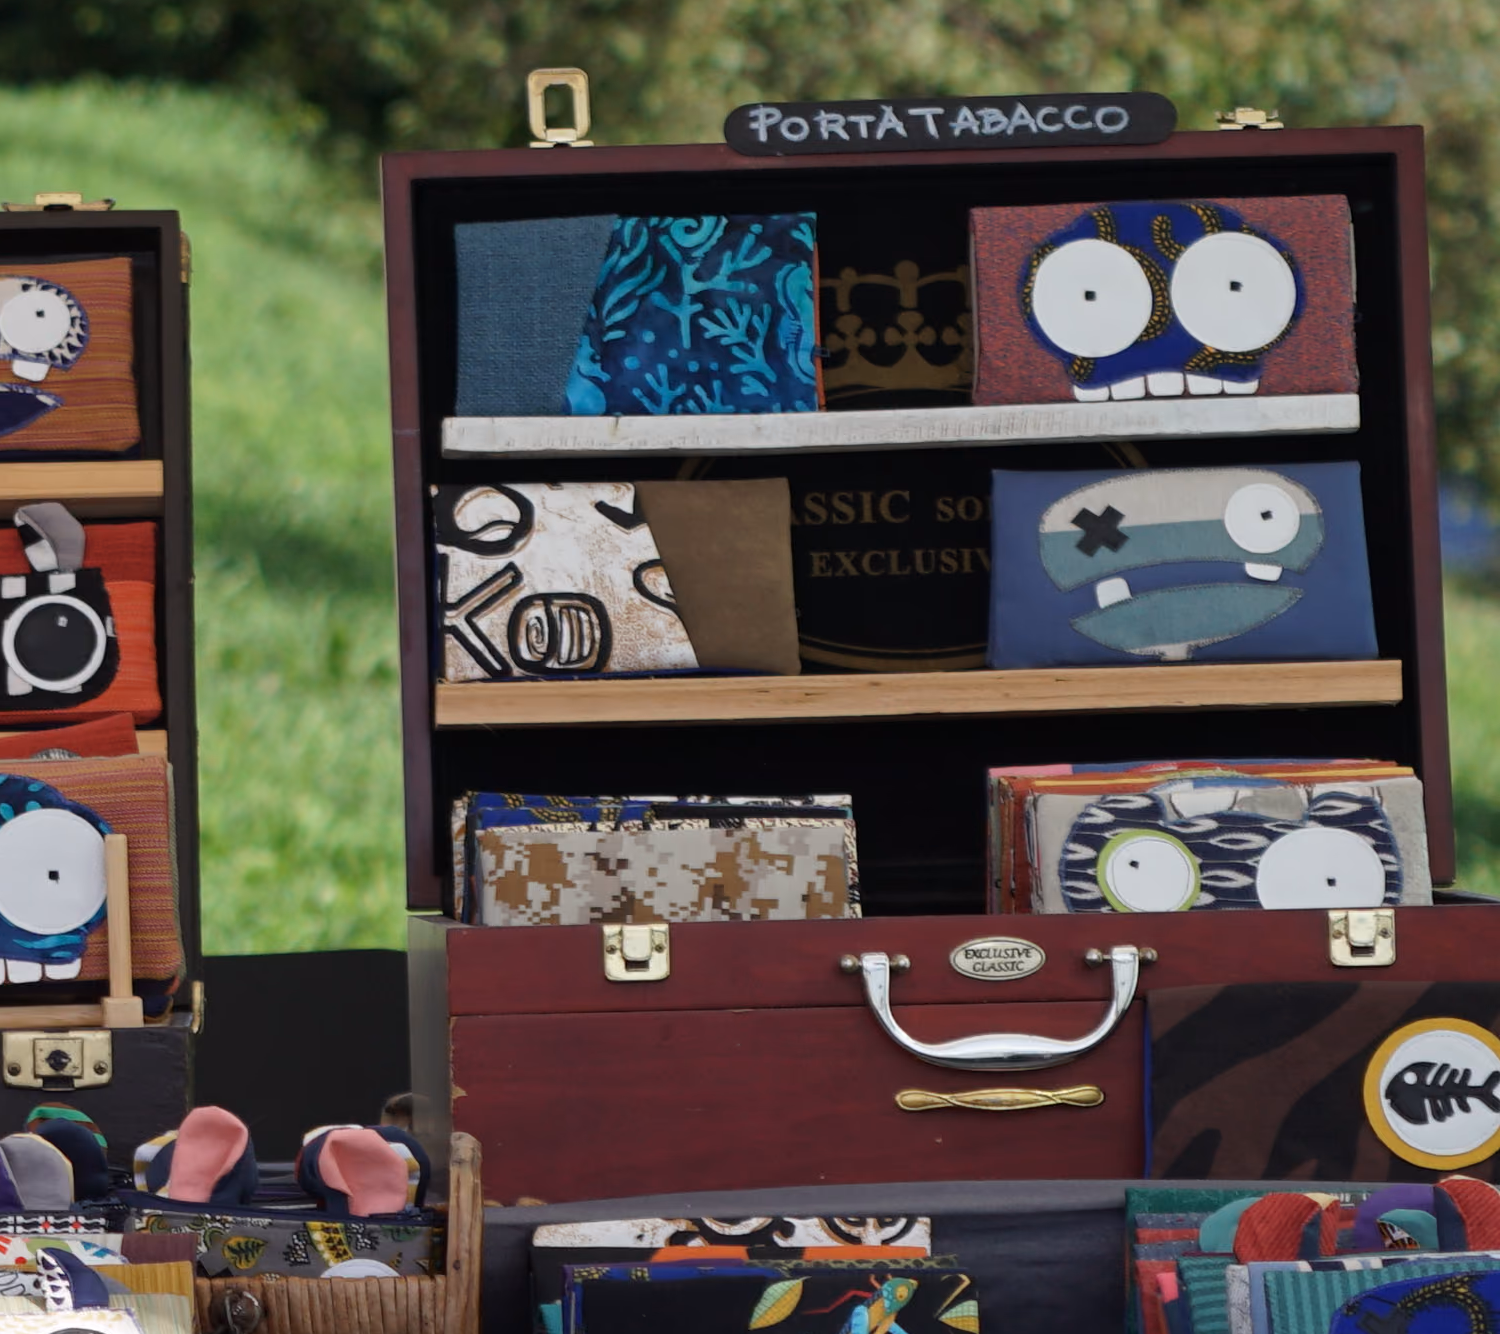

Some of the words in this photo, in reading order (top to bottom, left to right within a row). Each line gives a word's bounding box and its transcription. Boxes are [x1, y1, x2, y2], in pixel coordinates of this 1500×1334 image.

[791, 489, 910, 525] SSIC
[964, 948, 1033, 960] EXCLUSIVE
[972, 961, 1025, 972] CLASSIC
